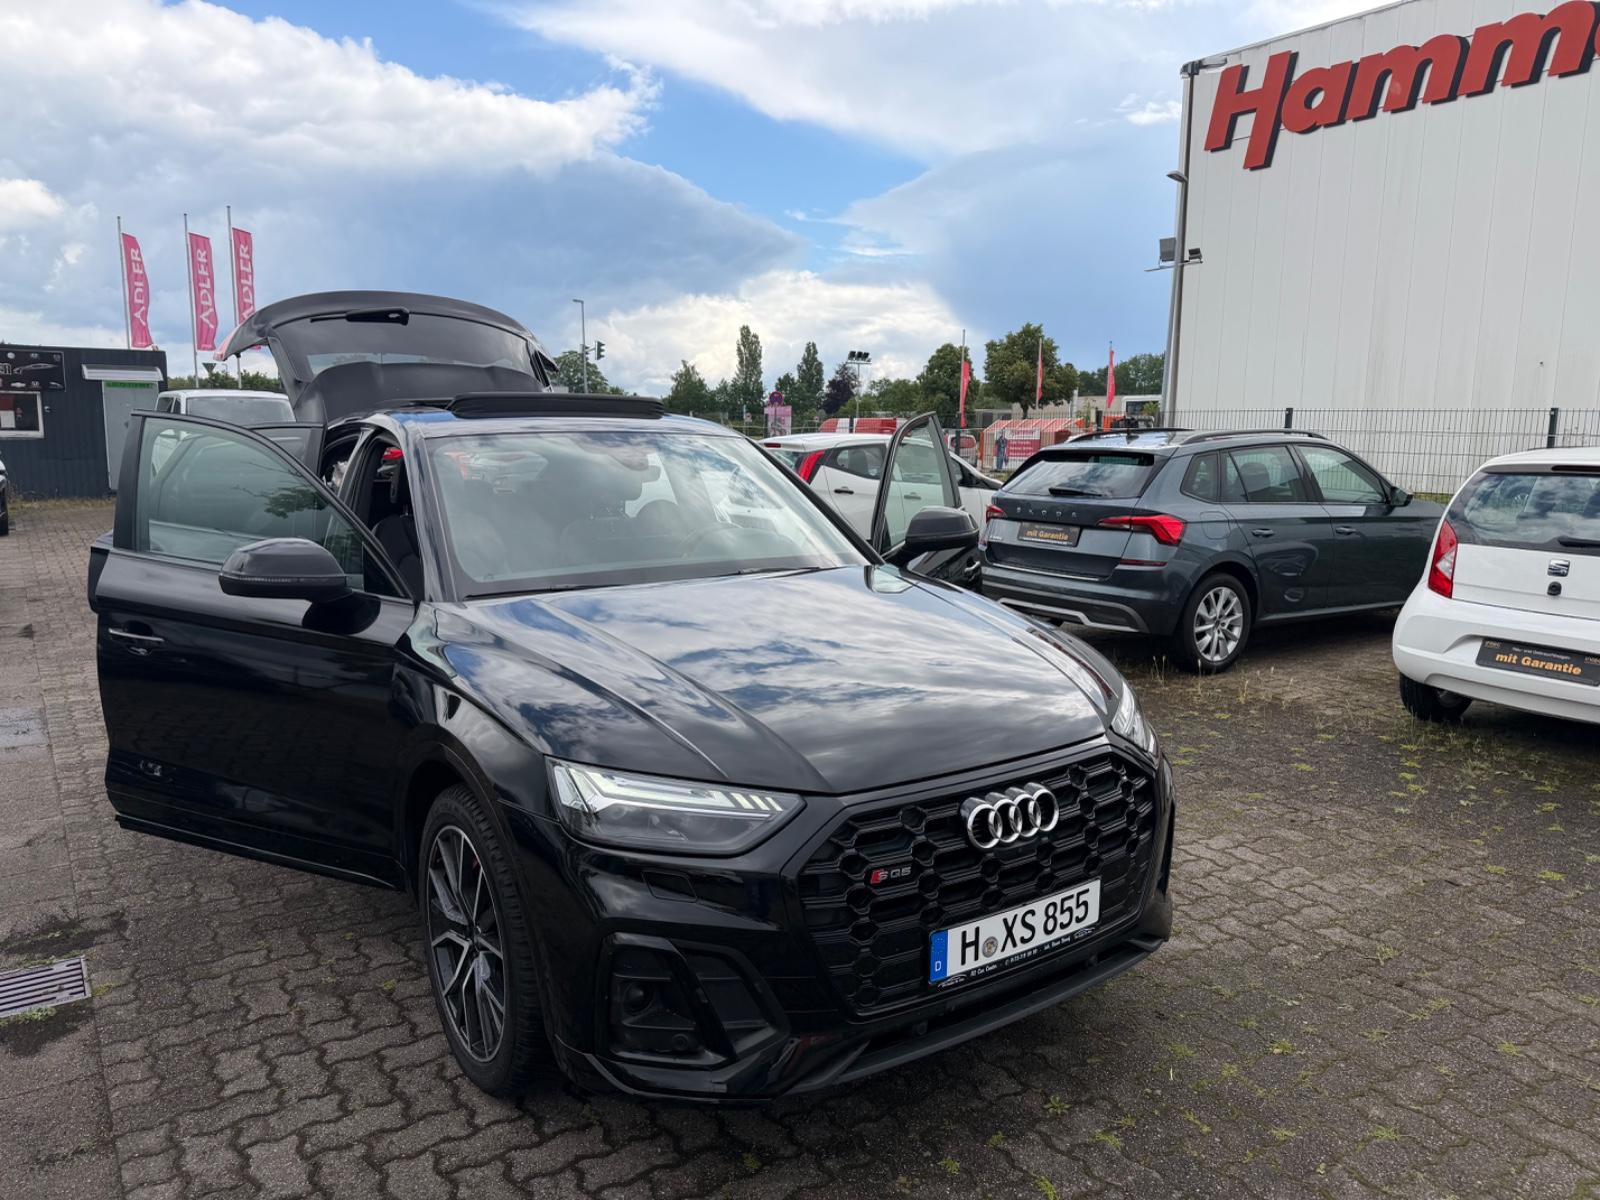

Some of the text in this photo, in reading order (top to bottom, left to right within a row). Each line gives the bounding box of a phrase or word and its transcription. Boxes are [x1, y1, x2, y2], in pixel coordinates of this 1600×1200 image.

[1204, 0, 1600, 170] Hamm
[130, 247, 146, 326] ADLER
[196, 248, 214, 329] ADLER
[1025, 529, 1069, 541] mit Garantie
[1495, 653, 1518, 665] mit
[1521, 656, 1582, 676] Garantie
[934, 960, 942, 972] D
[960, 926, 980, 966] H
[1001, 909, 1036, 952] XS
[1043, 888, 1090, 936] 855
